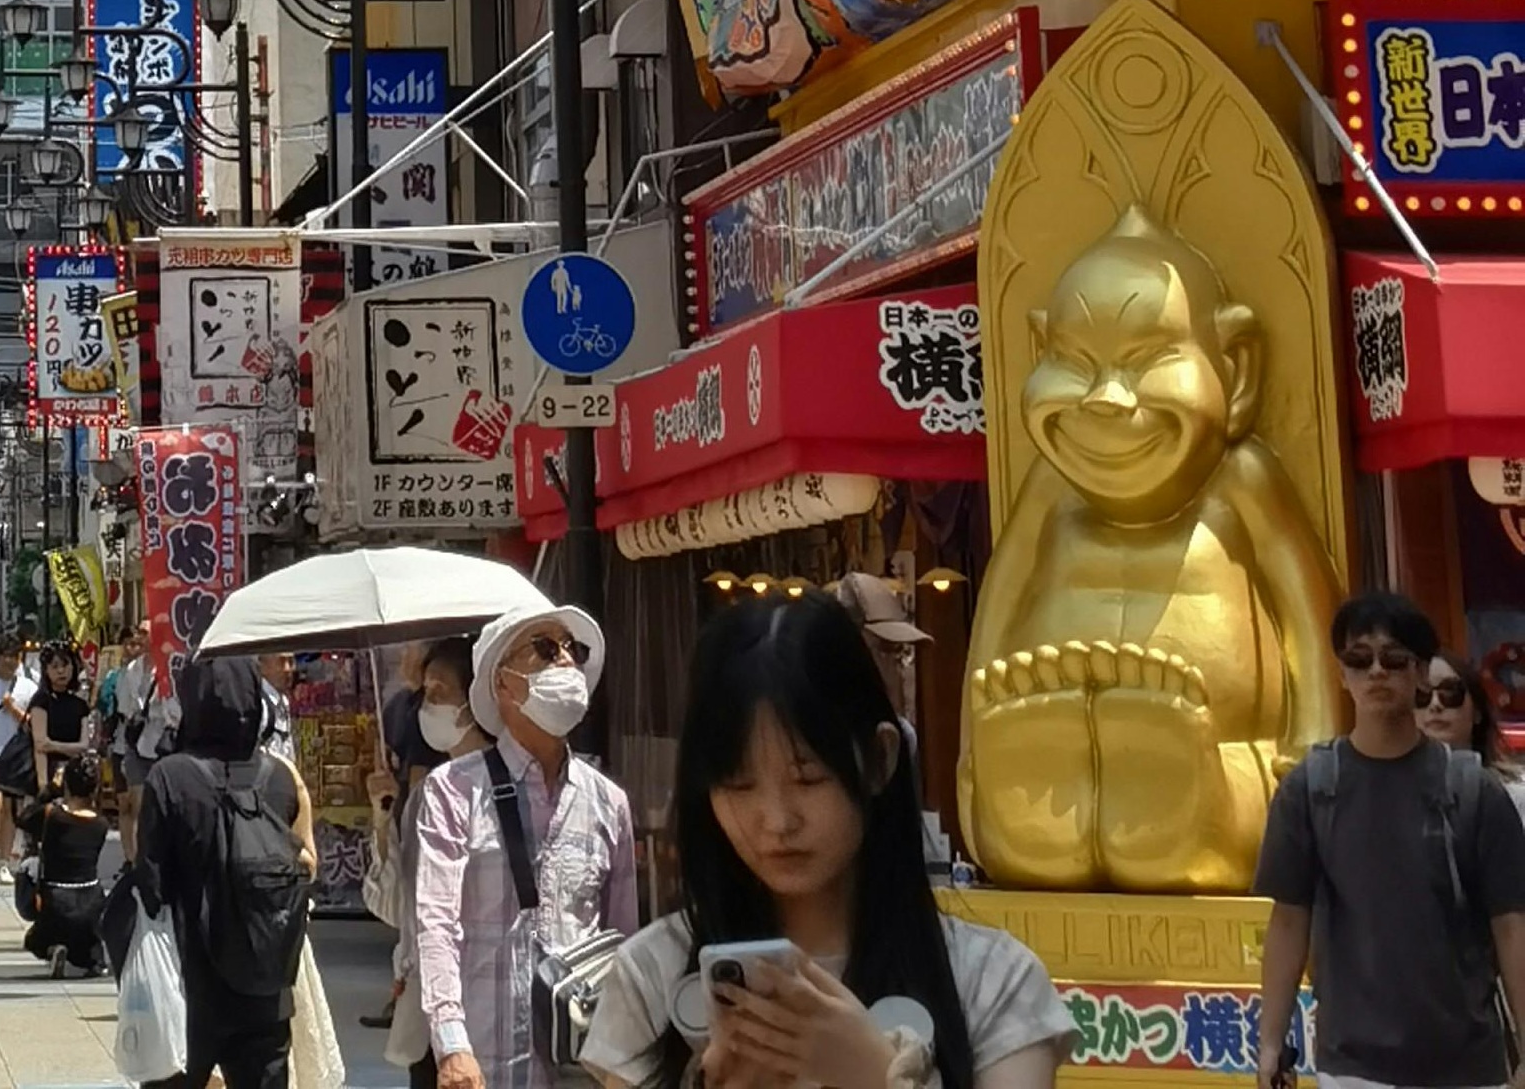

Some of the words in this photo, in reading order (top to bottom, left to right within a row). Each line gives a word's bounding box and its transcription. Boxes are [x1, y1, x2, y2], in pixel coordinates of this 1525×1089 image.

[1388, 36, 1434, 166] 新世界
[367, 116, 431, 129] サヒビール
[56, 260, 95, 277] Asahi
[64, 282, 103, 367] 串カツ
[398, 473, 514, 492] カウンター席
